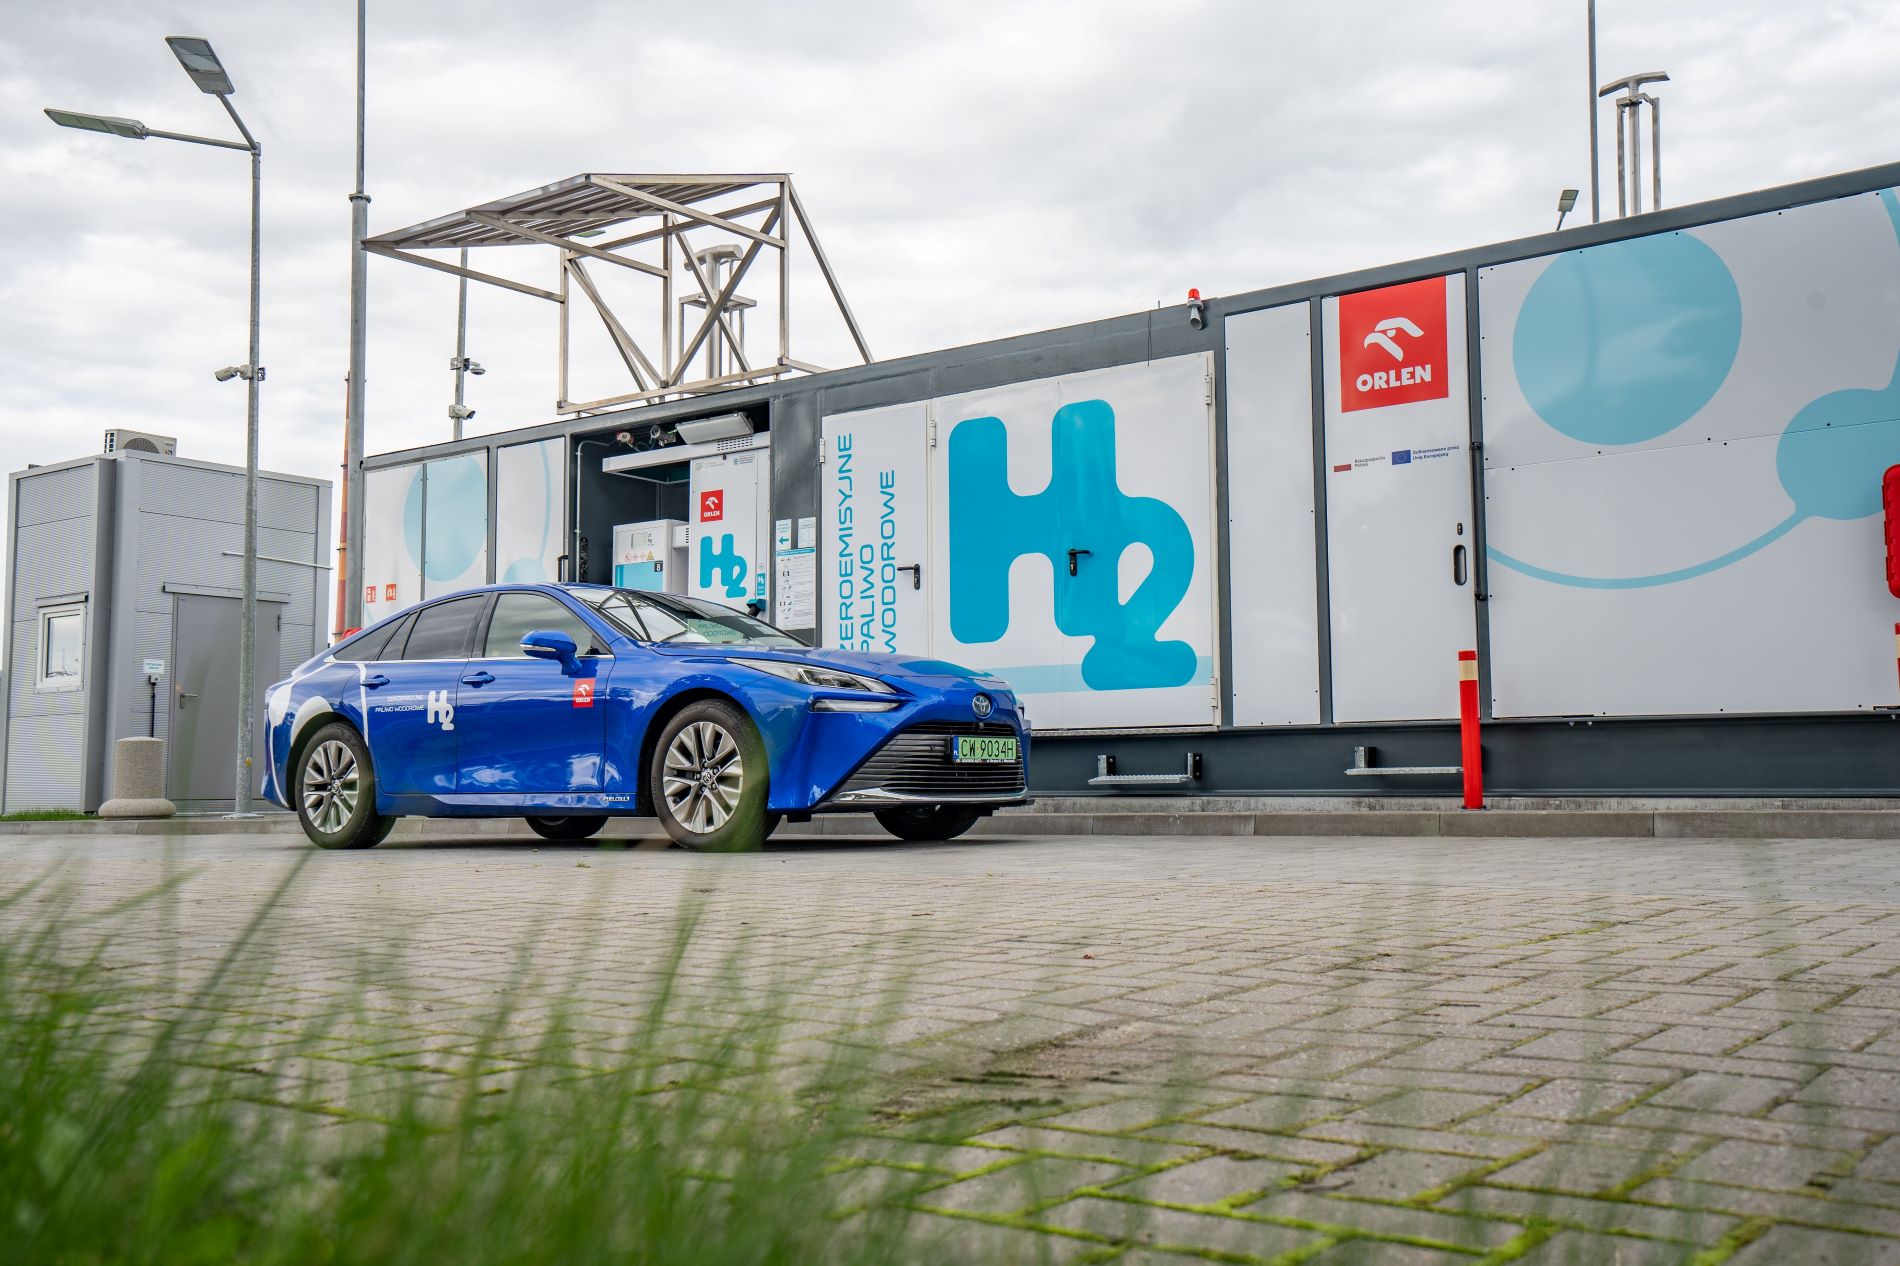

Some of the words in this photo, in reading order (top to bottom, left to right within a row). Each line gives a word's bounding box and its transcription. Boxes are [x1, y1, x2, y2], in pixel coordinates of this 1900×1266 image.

[1356, 364, 1432, 392] ORLEN
[703, 510, 720, 518] ORLEN
[880, 470, 896, 654] WODOROWE
[949, 399, 1197, 691] H2
[700, 533, 748, 599] H2
[860, 544, 875, 652] PALIWO
[394, 704, 425, 712] WODOROWE
[427, 690, 454, 730] H2
[961, 739, 976, 757] CW
[980, 739, 1014, 757] 9034H
